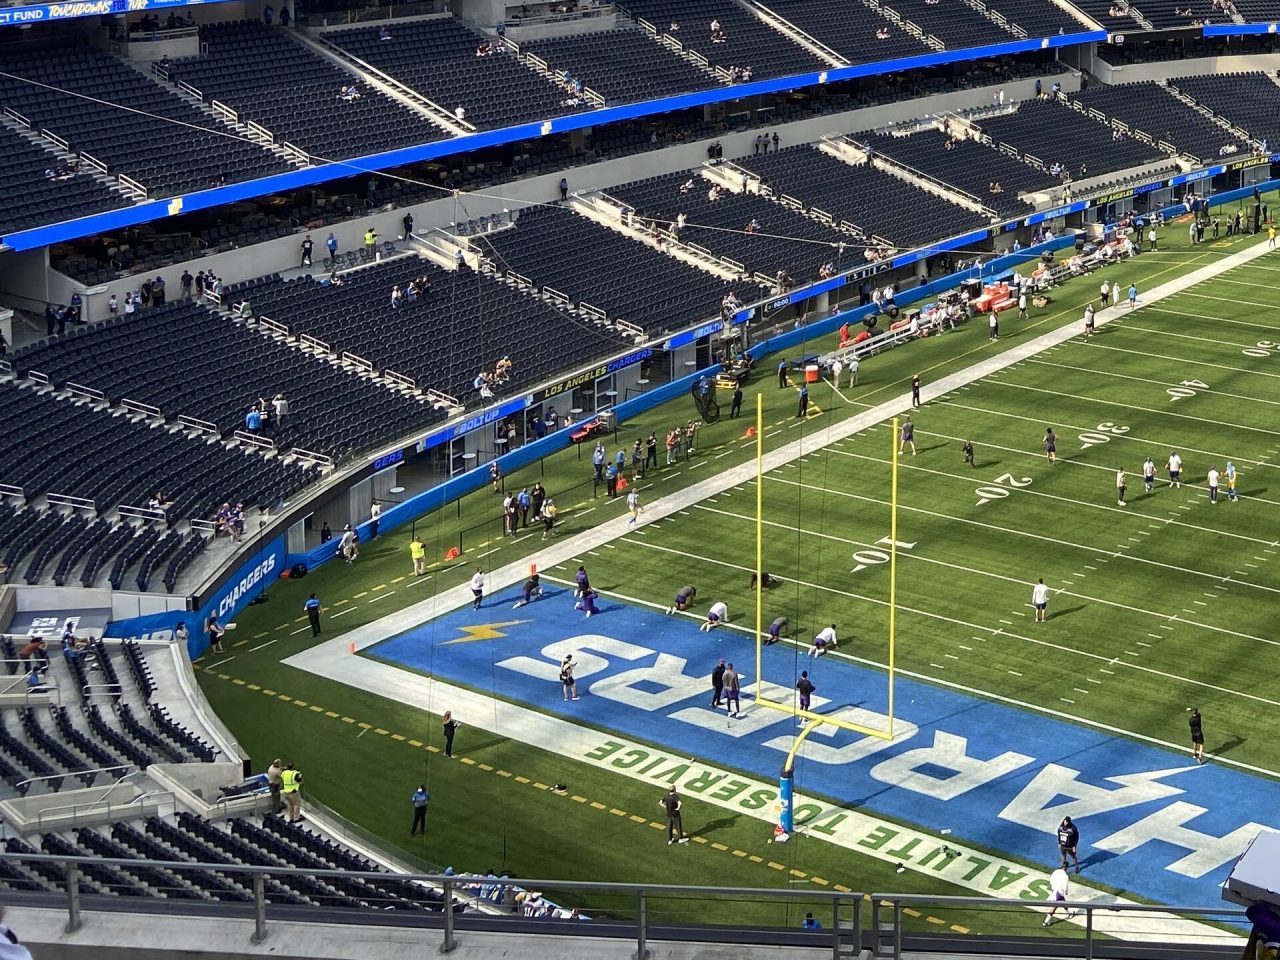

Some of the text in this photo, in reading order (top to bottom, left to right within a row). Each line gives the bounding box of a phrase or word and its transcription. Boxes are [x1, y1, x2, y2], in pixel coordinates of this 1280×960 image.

[13, 10, 43, 21] FUND
[49, 0, 113, 18] TOUCHDOWNS
[1232, 161, 1242, 170] LOS
[1243, 158, 1268, 168] ANGELES
[1097, 182, 1163, 205] LOS ANGELES CHARGERS
[1005, 222, 1019, 232] ERS
[545, 348, 653, 398] LOS ANGELES CHARGERS
[1165, 379, 1210, 398] 40
[453, 408, 500, 437] #BOLTUP
[1077, 421, 1131, 445] 30
[374, 450, 403, 471] GERS
[974, 472, 1033, 500] 20
[851, 535, 918, 565] 10
[219, 553, 276, 617] CHARGERS
[584, 740, 1057, 901] SALUTE TO SERVICE
